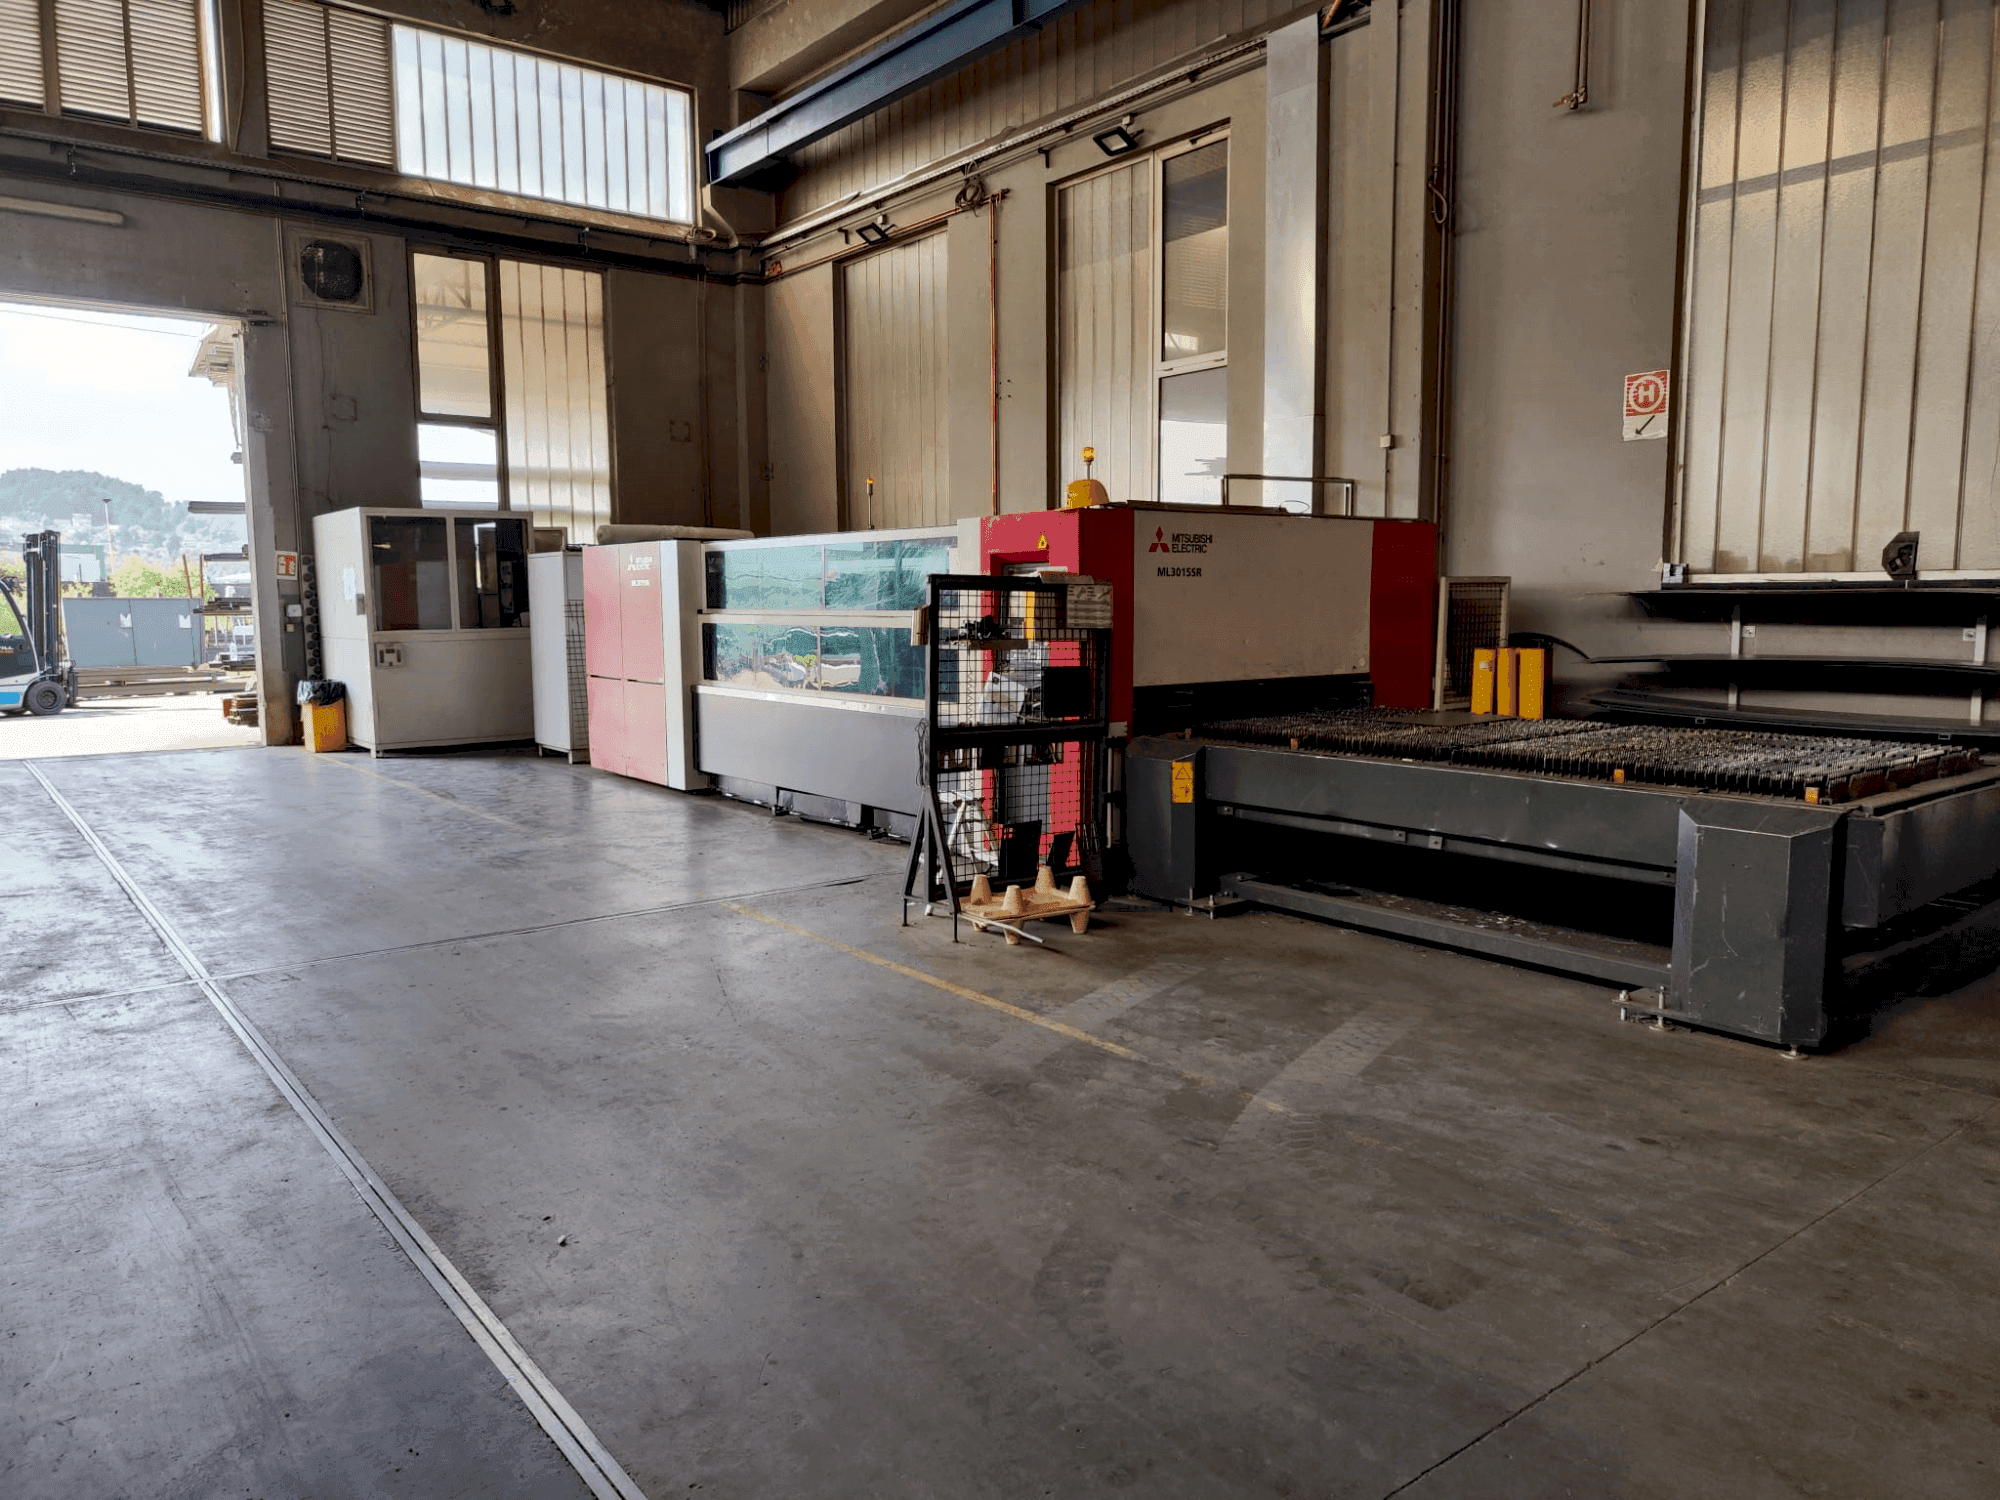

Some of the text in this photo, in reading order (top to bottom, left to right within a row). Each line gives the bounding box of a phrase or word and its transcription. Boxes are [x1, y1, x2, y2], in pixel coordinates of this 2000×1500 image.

[1171, 533, 1213, 543] MITSUBISHI
[1171, 543, 1208, 553] ELECTRIC
[1157, 566, 1202, 577] ML3015SR
